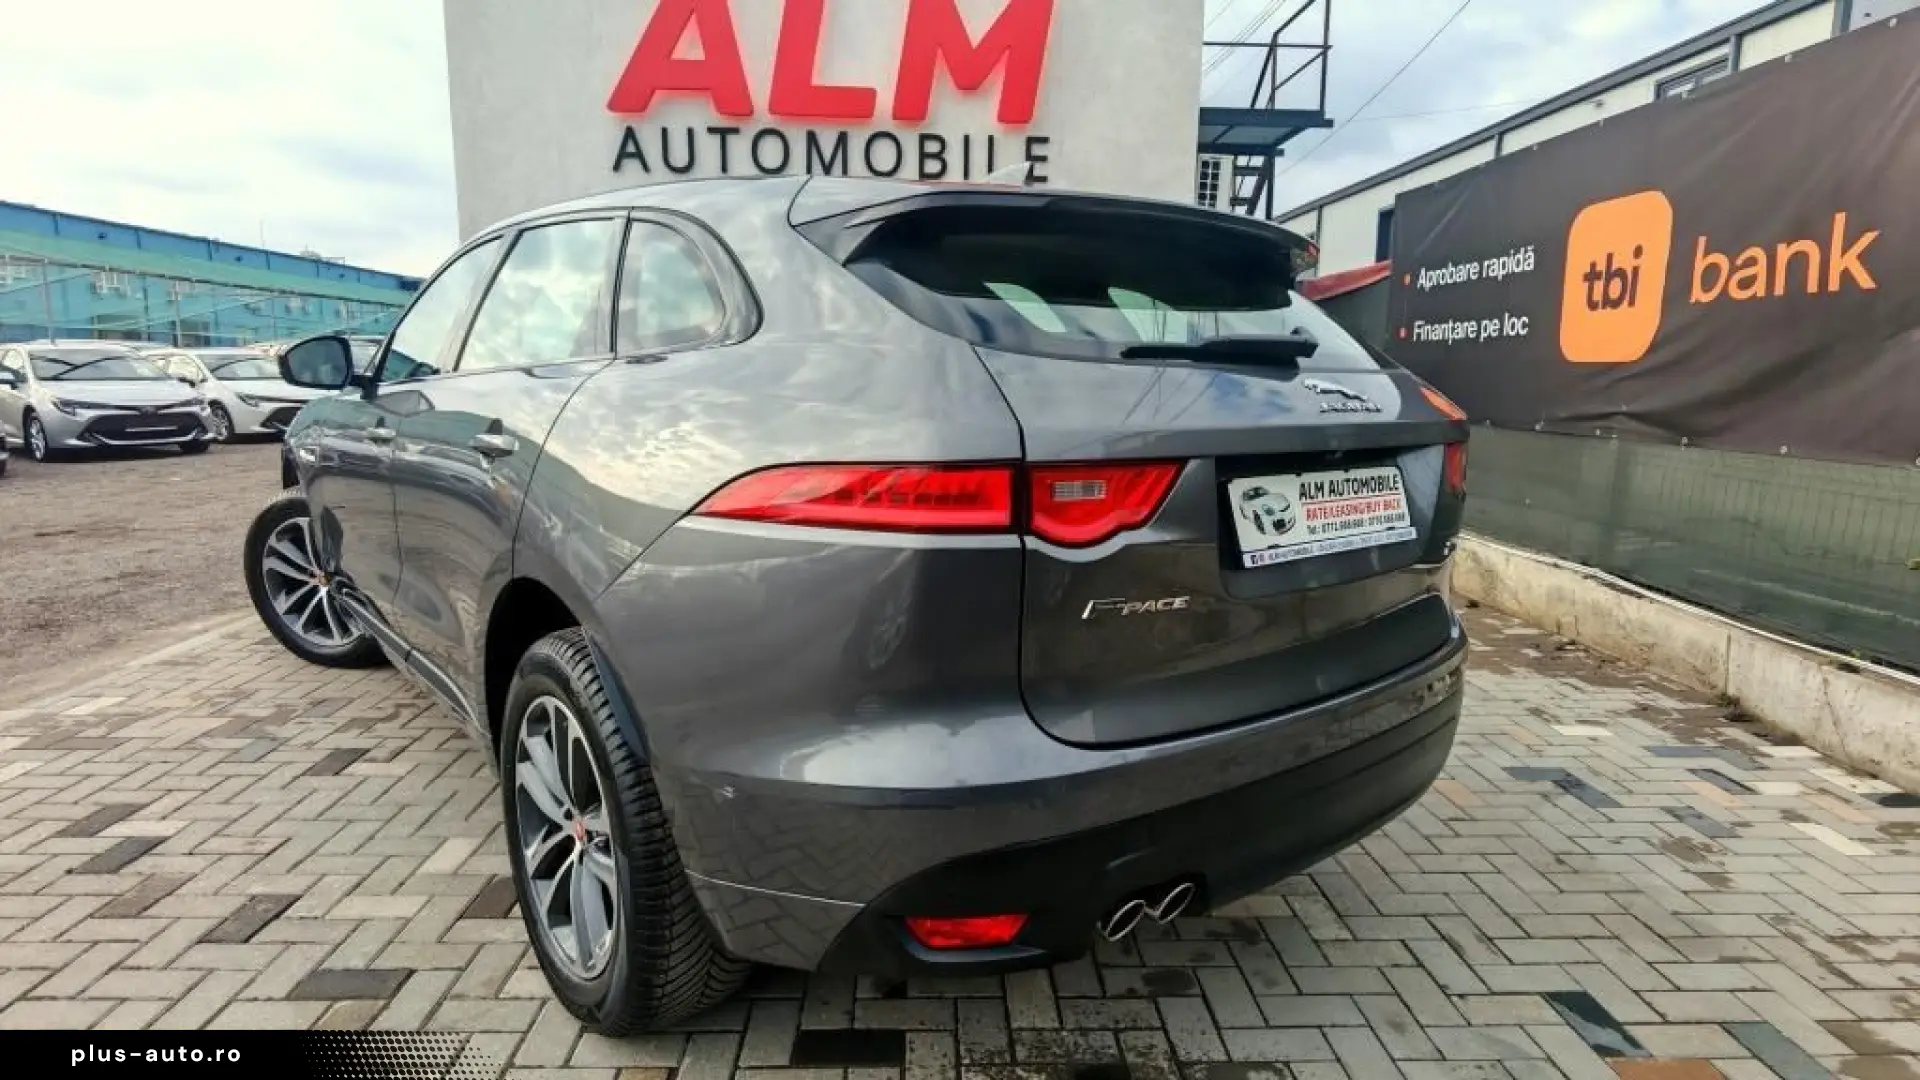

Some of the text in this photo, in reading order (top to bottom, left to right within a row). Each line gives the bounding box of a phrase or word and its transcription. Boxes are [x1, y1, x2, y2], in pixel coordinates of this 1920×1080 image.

[607, 0, 1054, 125] ALM
[612, 126, 1051, 184] AUTOMOBILE
[1416, 244, 1536, 293] Aprobare rapidă
[1582, 211, 1881, 312] tbi bank
[1412, 311, 1530, 346] Finanțare pe loc
[1299, 473, 1400, 501] ALM AUTOMOBILE
